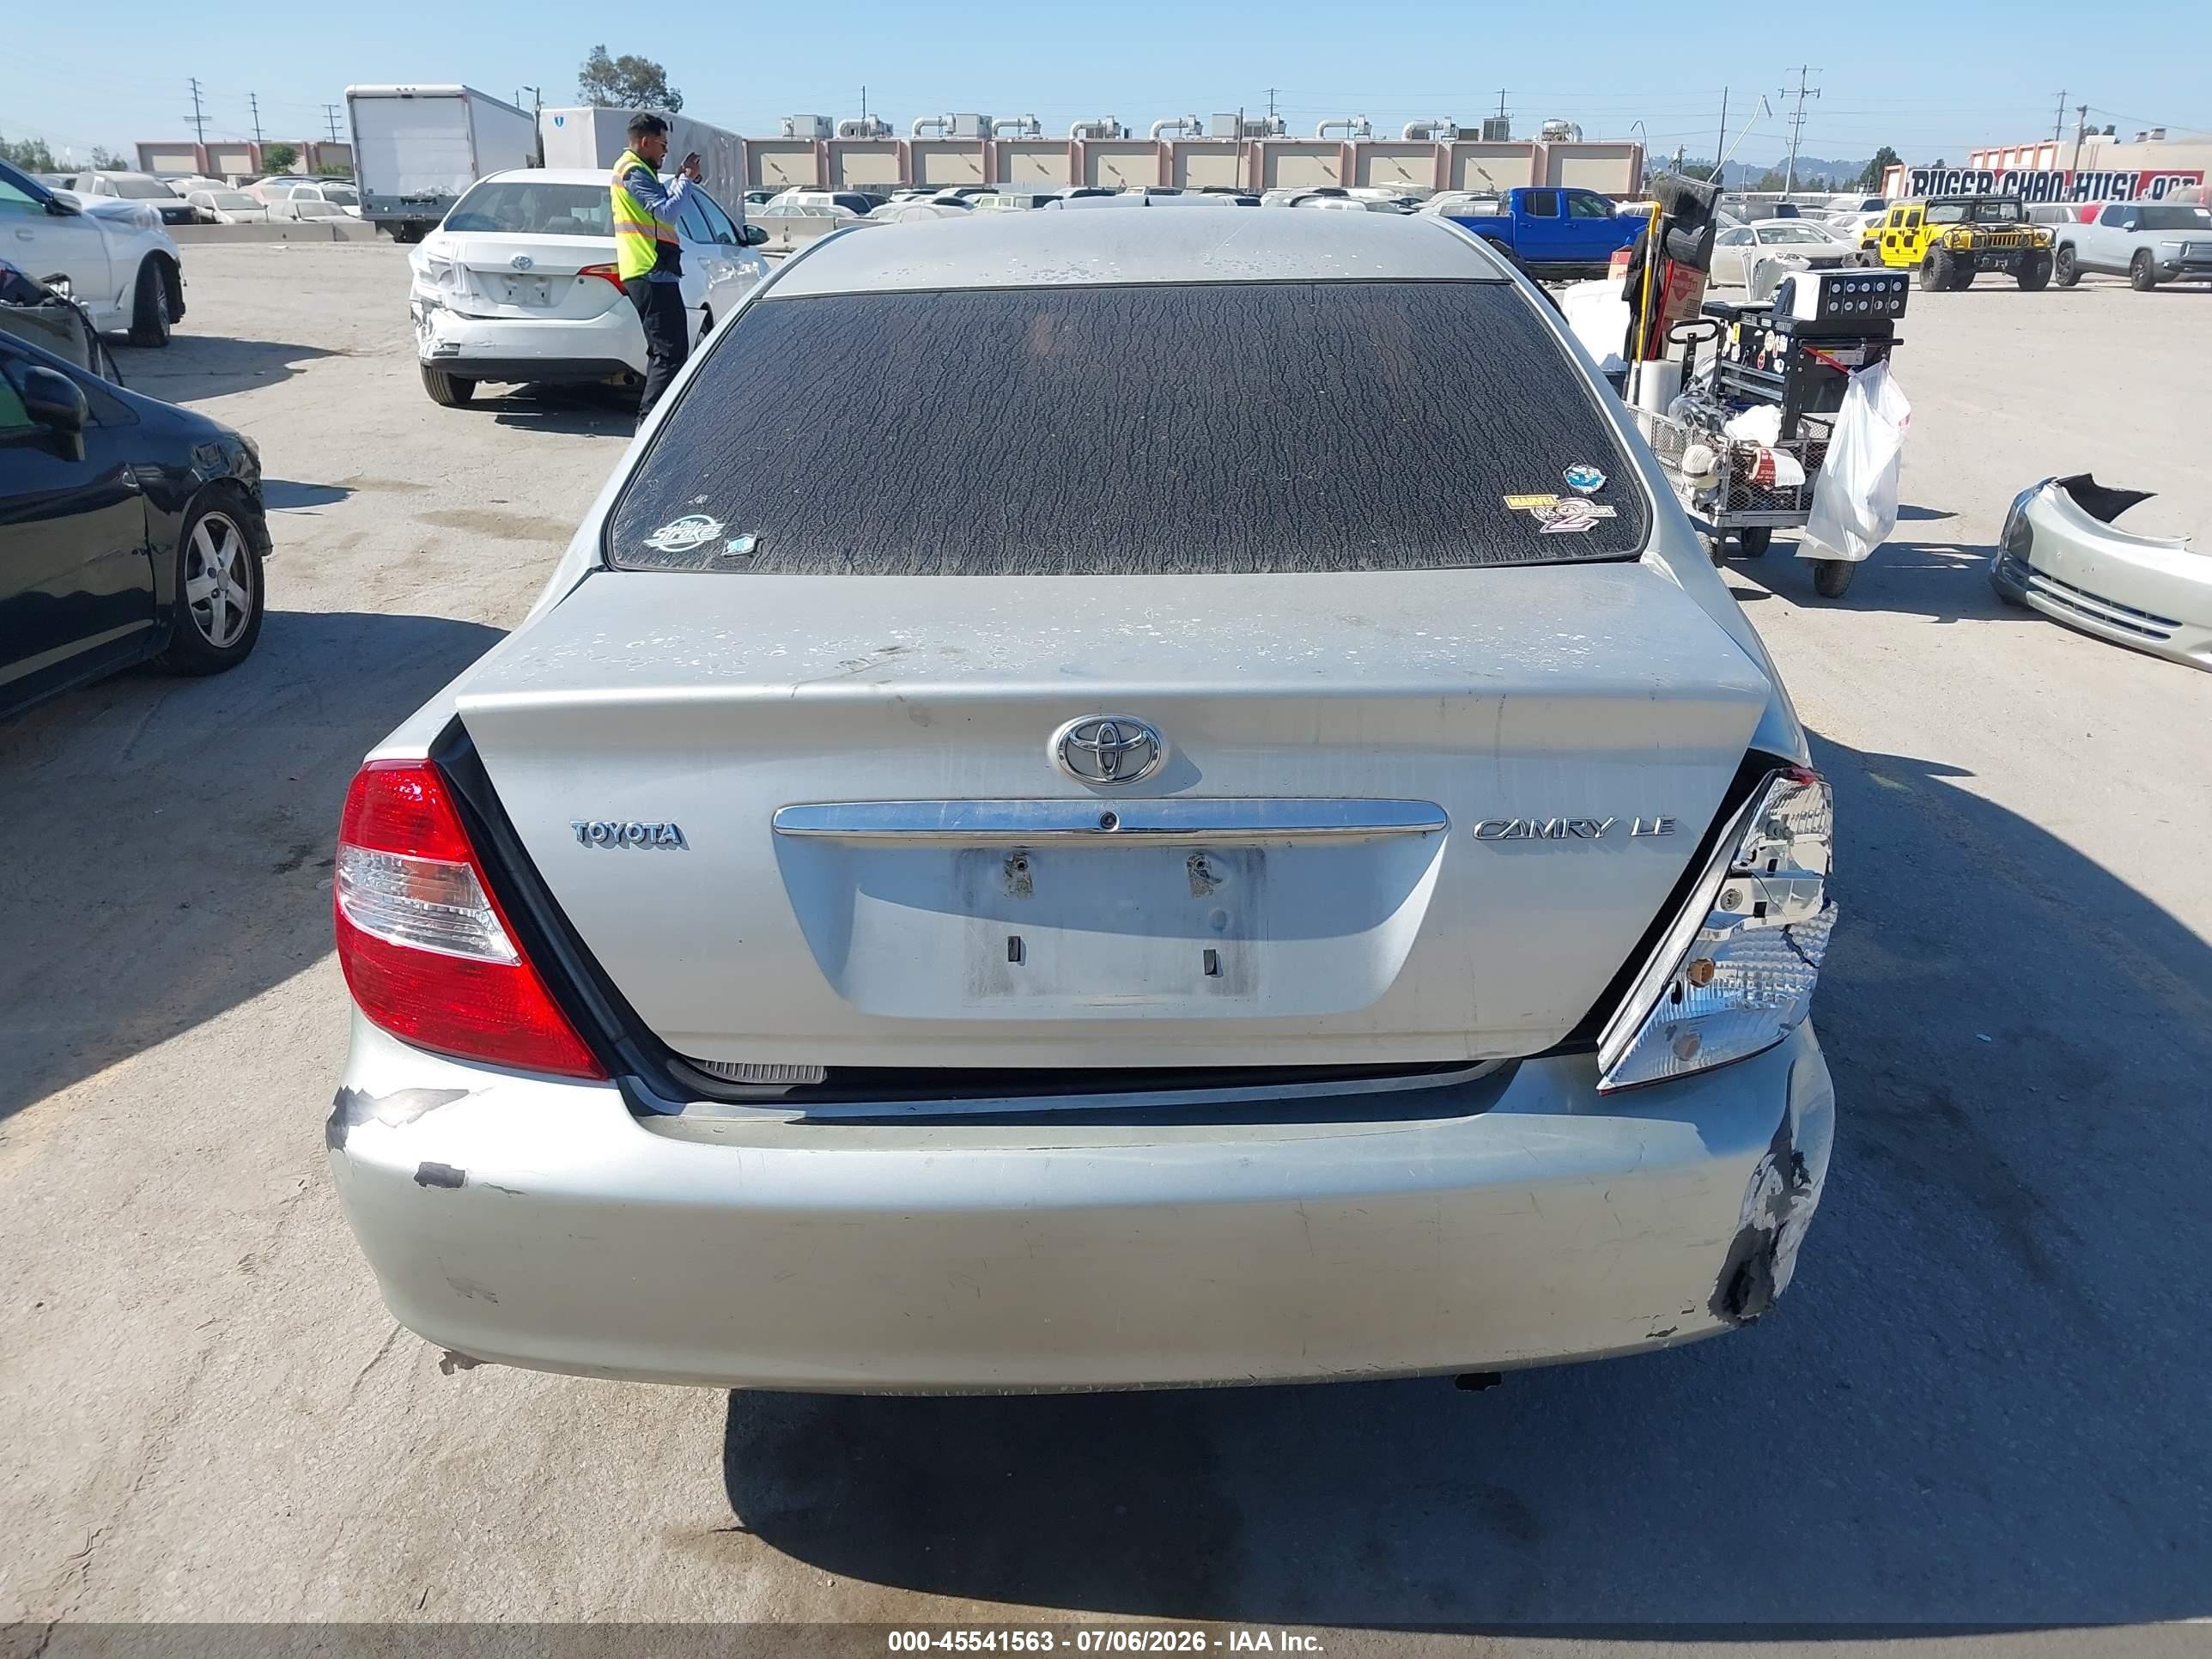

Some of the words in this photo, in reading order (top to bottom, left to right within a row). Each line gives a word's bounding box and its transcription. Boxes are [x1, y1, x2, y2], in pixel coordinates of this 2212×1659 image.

[1507, 496, 1556, 507] MARVEL
[678, 520, 702, 529] The
[652, 525, 721, 541] Strokes
[570, 820, 683, 844] TOYOTA
[1472, 817, 1621, 840] CAMRY
[1629, 816, 1677, 837] LE
